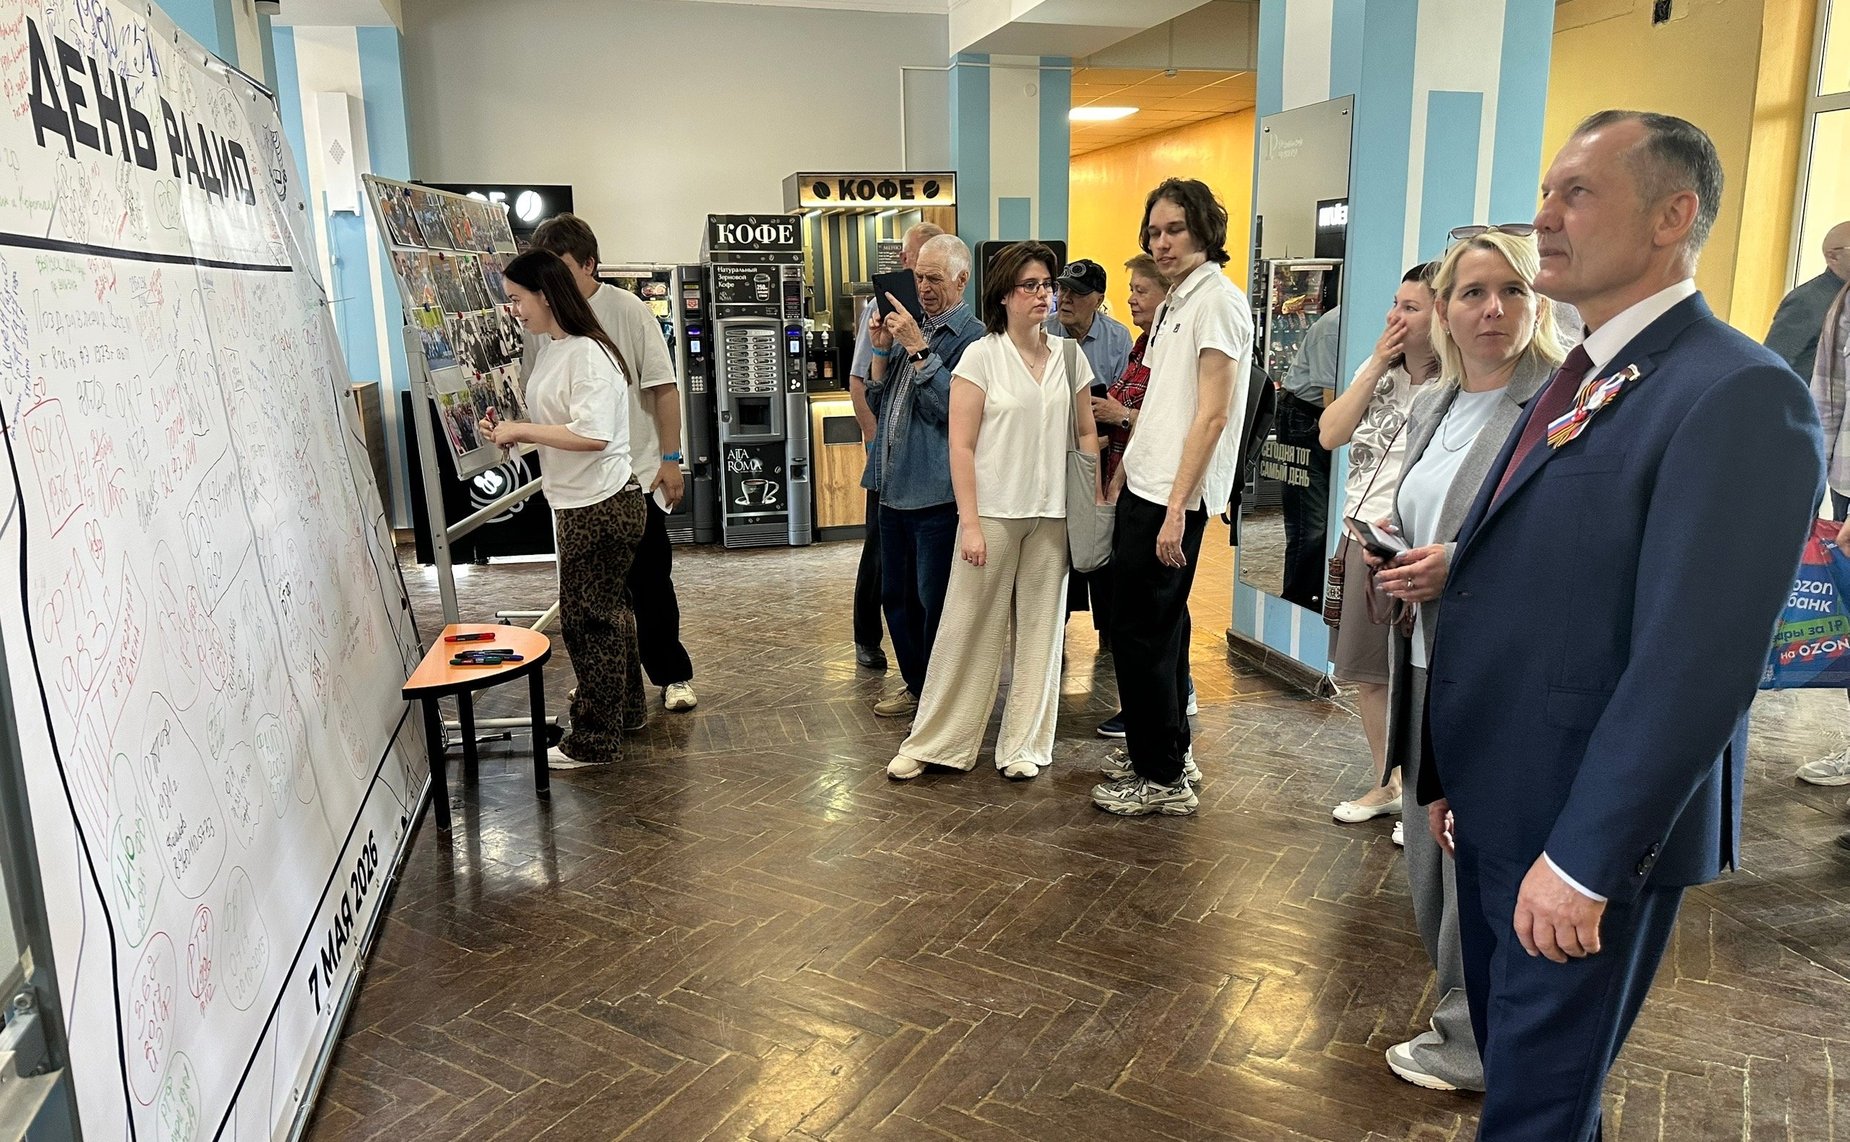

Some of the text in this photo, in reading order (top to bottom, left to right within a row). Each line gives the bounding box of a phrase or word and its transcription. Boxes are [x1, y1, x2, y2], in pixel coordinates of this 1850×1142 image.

[27, 16, 157, 171] ДЕНЬ
[160, 95, 257, 207] РАДИО
[839, 179, 915, 200] КОФЕ
[717, 223, 794, 244] КОФЕ
[717, 266, 758, 274] Натуральный
[718, 273, 747, 281] Зерновой
[1263, 441, 1311, 466] СЕГОДНЯ ТОТ
[727, 459, 763, 473] ROMA
[1260, 461, 1311, 488] САМЫЙ ДЕНЬ
[1793, 580, 1833, 595] ozon
[1788, 594, 1832, 613] банк
[1808, 625, 1824, 635] за
[1781, 638, 1850, 659] на OZON
[308, 829, 378, 1016] 7 МАЯ 2026
